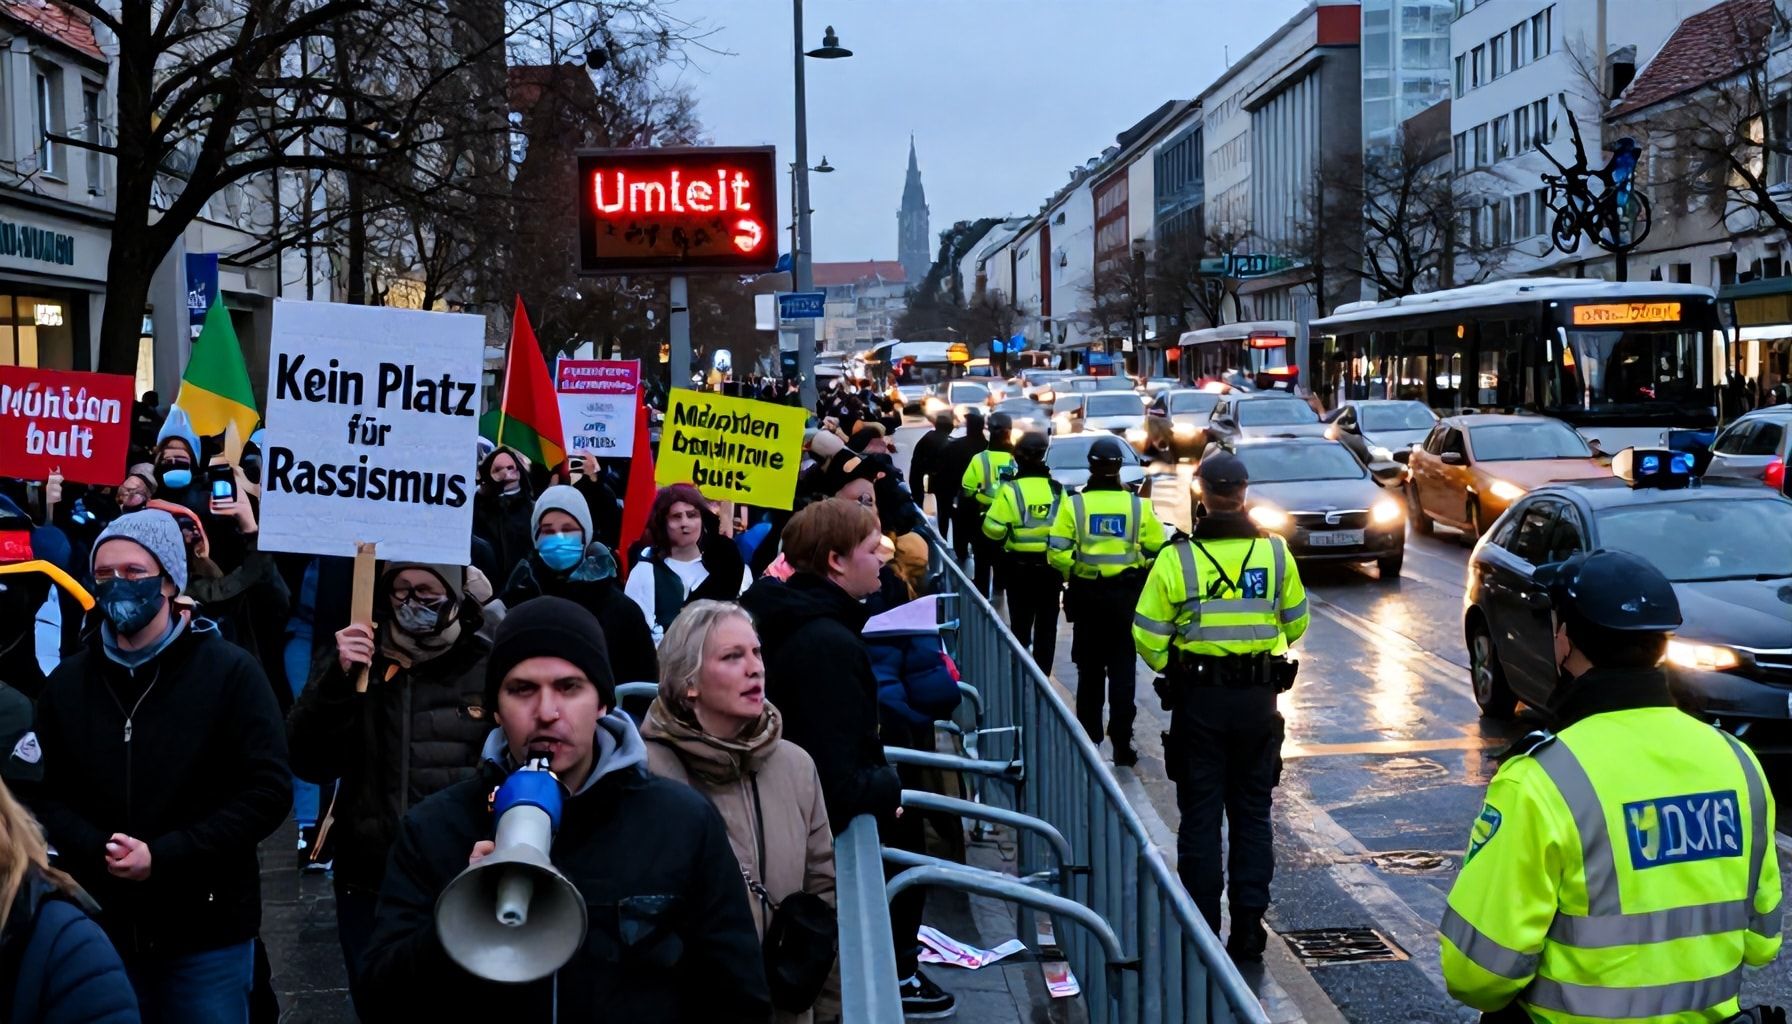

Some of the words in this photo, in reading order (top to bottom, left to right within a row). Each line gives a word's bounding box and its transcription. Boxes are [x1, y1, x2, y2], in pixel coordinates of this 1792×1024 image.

[594, 168, 752, 213] Umleit
[276, 353, 364, 406] Kein
[377, 362, 476, 417] Platz
[348, 412, 392, 447] für
[266, 446, 468, 508] Rassismus
